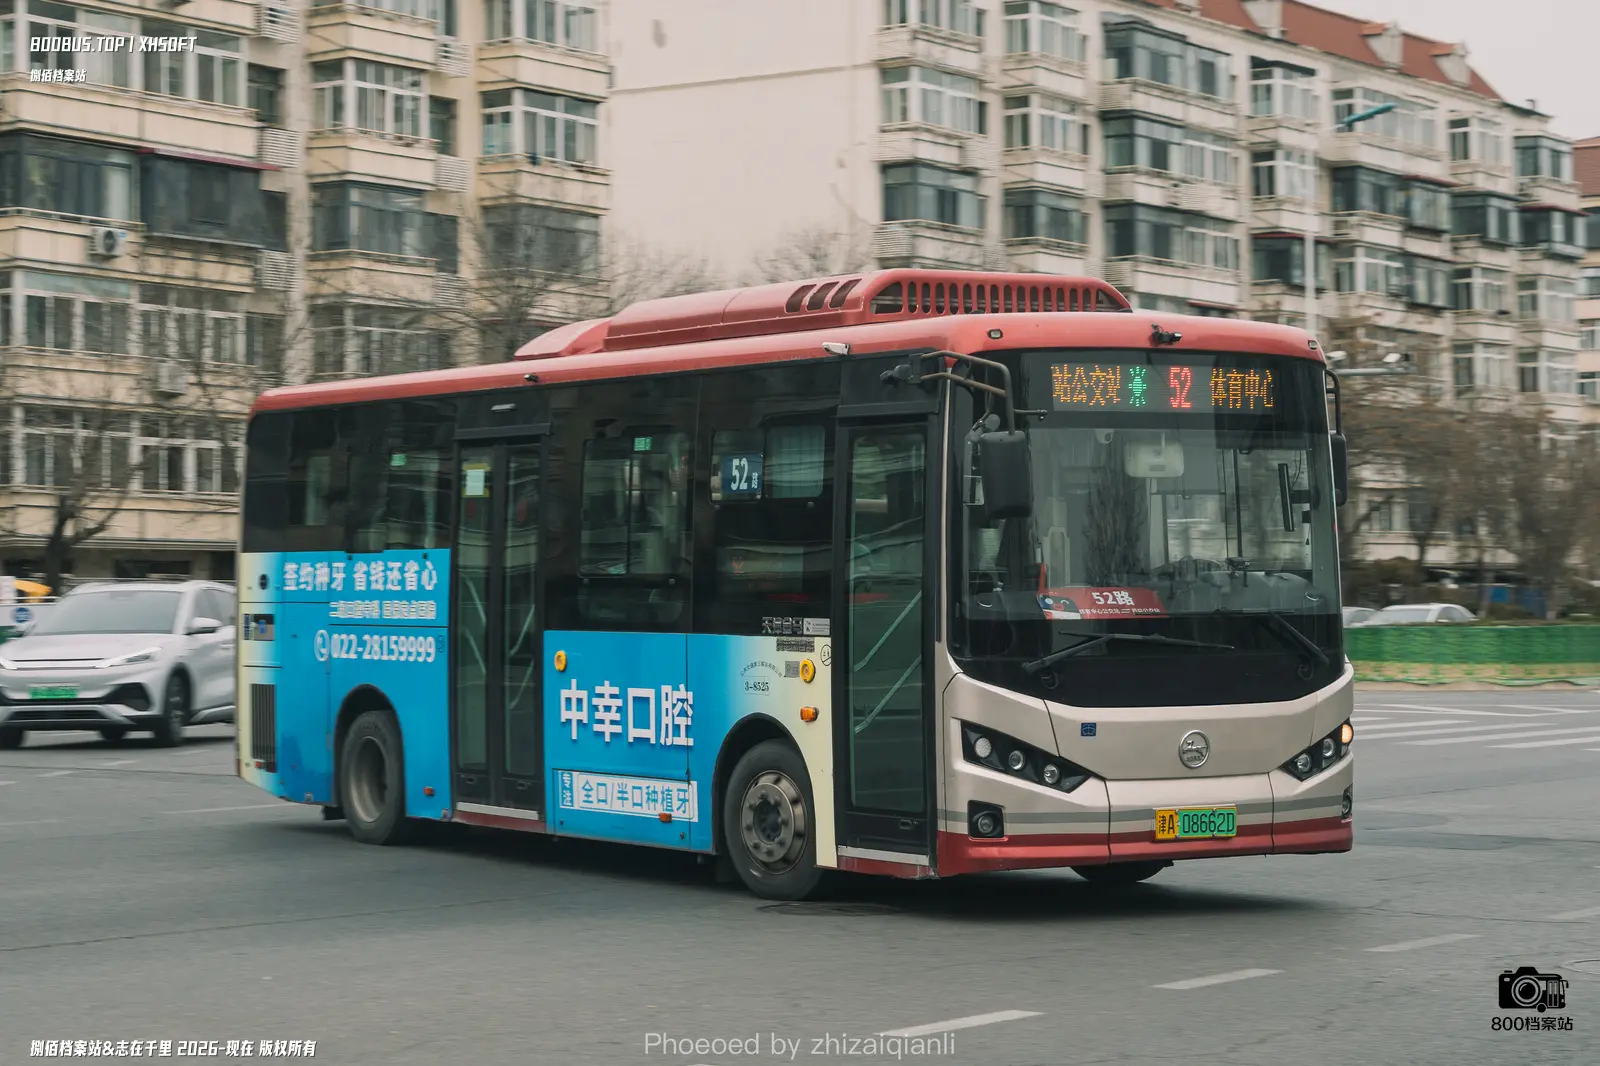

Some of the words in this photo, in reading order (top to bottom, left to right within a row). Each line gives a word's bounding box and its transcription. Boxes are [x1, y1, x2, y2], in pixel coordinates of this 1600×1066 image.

[1170, 367, 1191, 408] 52
[1210, 368, 1274, 409] 体育中心
[283, 562, 346, 591] 签约种牙
[353, 560, 438, 591] 省钱还省心
[1092, 590, 1135, 606] 52路
[331, 633, 436, 662] 022-28159999
[744, 681, 769, 692] 3-8525
[560, 678, 694, 746] 中幸口腔
[1158, 814, 1175, 835] 津A
[1182, 812, 1235, 834] 08662D
